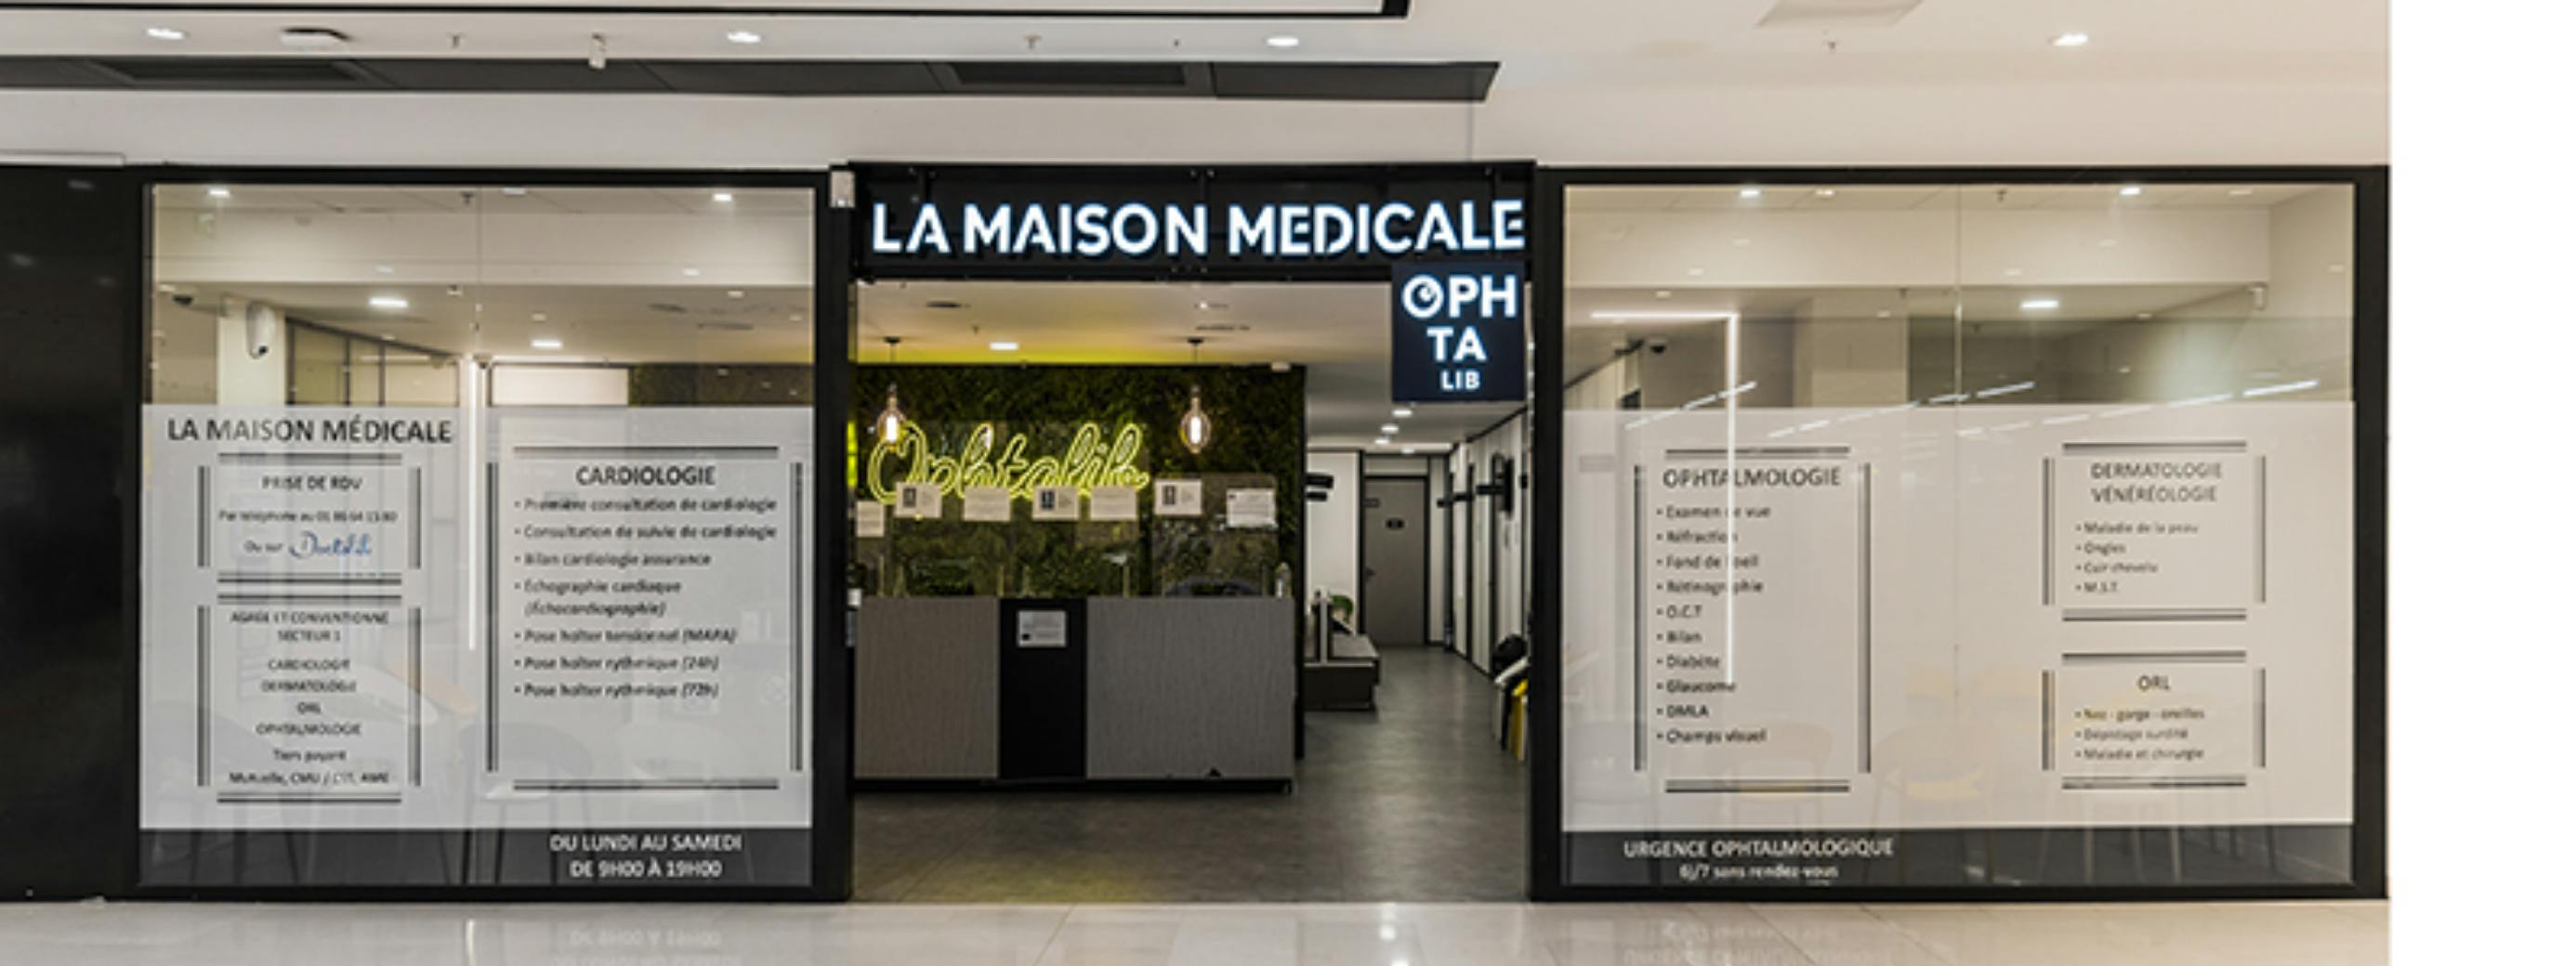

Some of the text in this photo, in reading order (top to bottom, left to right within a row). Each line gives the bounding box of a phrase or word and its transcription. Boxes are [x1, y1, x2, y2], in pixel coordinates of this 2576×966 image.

[872, 200, 1525, 255] LA MAISON MEDICALE
[1402, 274, 1517, 319] OPH
[1426, 326, 1487, 362] TA
[1441, 370, 1480, 391] LIB
[167, 414, 453, 443] LA MAISON MÉDICALE
[576, 464, 716, 486] CARDIOLOGIE
[2091, 462, 2223, 479] DERMATOLOGIE
[262, 475, 362, 490] PRISE DE RDV
[524, 497, 777, 515] Première consultation de cardiologie
[1666, 504, 1720, 518] Examen
[1745, 507, 1771, 518] vue
[524, 526, 777, 541] Consultation de suivie de cardiologie
[2083, 522, 2133, 534] Maladie
[2136, 522, 2151, 534] de
[2083, 541, 2126, 556] Ongles
[524, 554, 712, 569] Bilan cardiologie assurance
[1666, 555, 1700, 570] Fond
[1704, 555, 1721, 570] de
[611, 581, 681, 596] cardiaque
[278, 630, 330, 642] SECTEUR
[524, 631, 557, 642] Pose
[605, 630, 679, 642] tensionnel
[1666, 631, 1702, 644] Bilan
[269, 659, 350, 671] CARDIOLOGIE
[524, 658, 557, 670] Pose
[605, 658, 677, 672] rythmique
[261, 680, 356, 693] DERMATOLOGIE
[2136, 674, 2171, 692] ORL
[524, 685, 557, 697] Pose
[605, 685, 677, 700] rythmique
[1666, 704, 1710, 718] DMLA
[256, 724, 361, 737] OPHTALMOLOGIE
[1666, 729, 1768, 744] Champs visuel
[549, 833, 743, 852] DU LUNDI AU SAMEDI
[1623, 837, 1894, 859] URGENCE OPHTALMOLOGIQUE
[569, 859, 594, 878] DE
[598, 859, 645, 878] 9H00
[665, 859, 723, 878] 19H00
[1714, 865, 1745, 879] sans
